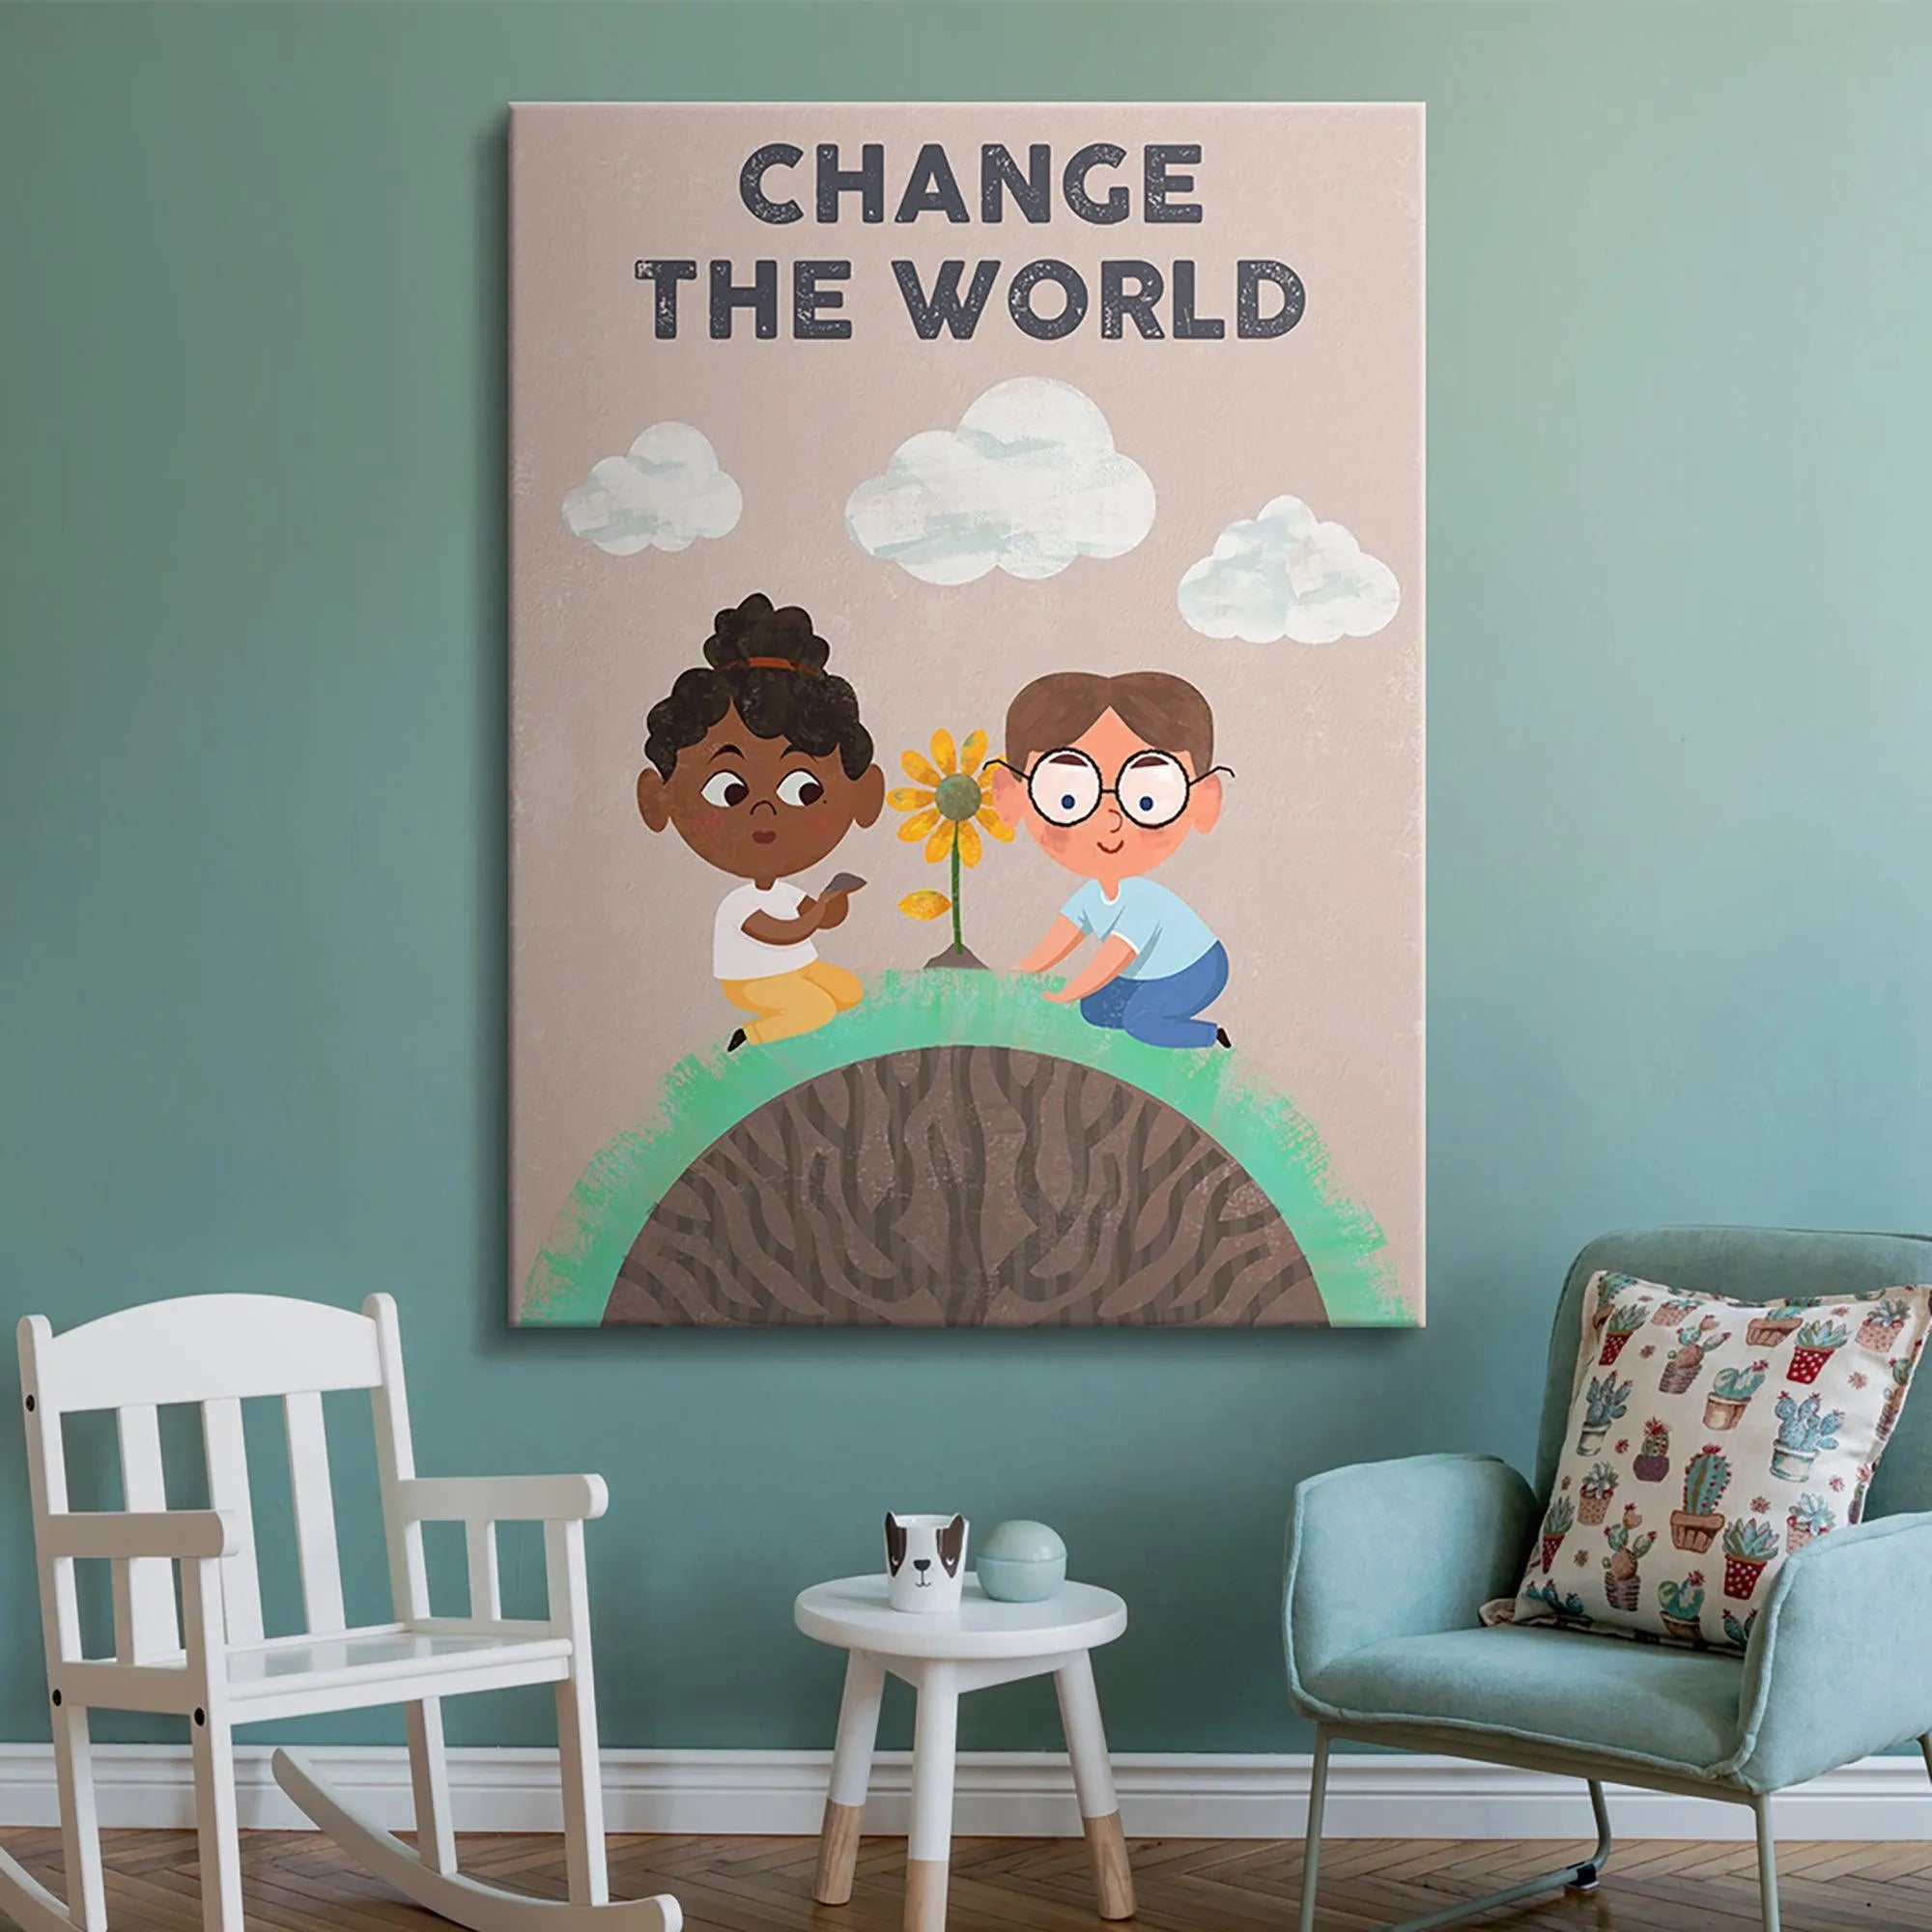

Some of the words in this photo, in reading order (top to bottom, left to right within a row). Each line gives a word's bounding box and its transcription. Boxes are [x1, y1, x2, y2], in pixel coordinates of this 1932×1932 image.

[739, 143, 1203, 224] CHANGE
[635, 259, 852, 340] THE
[891, 259, 1306, 341] WORLD
